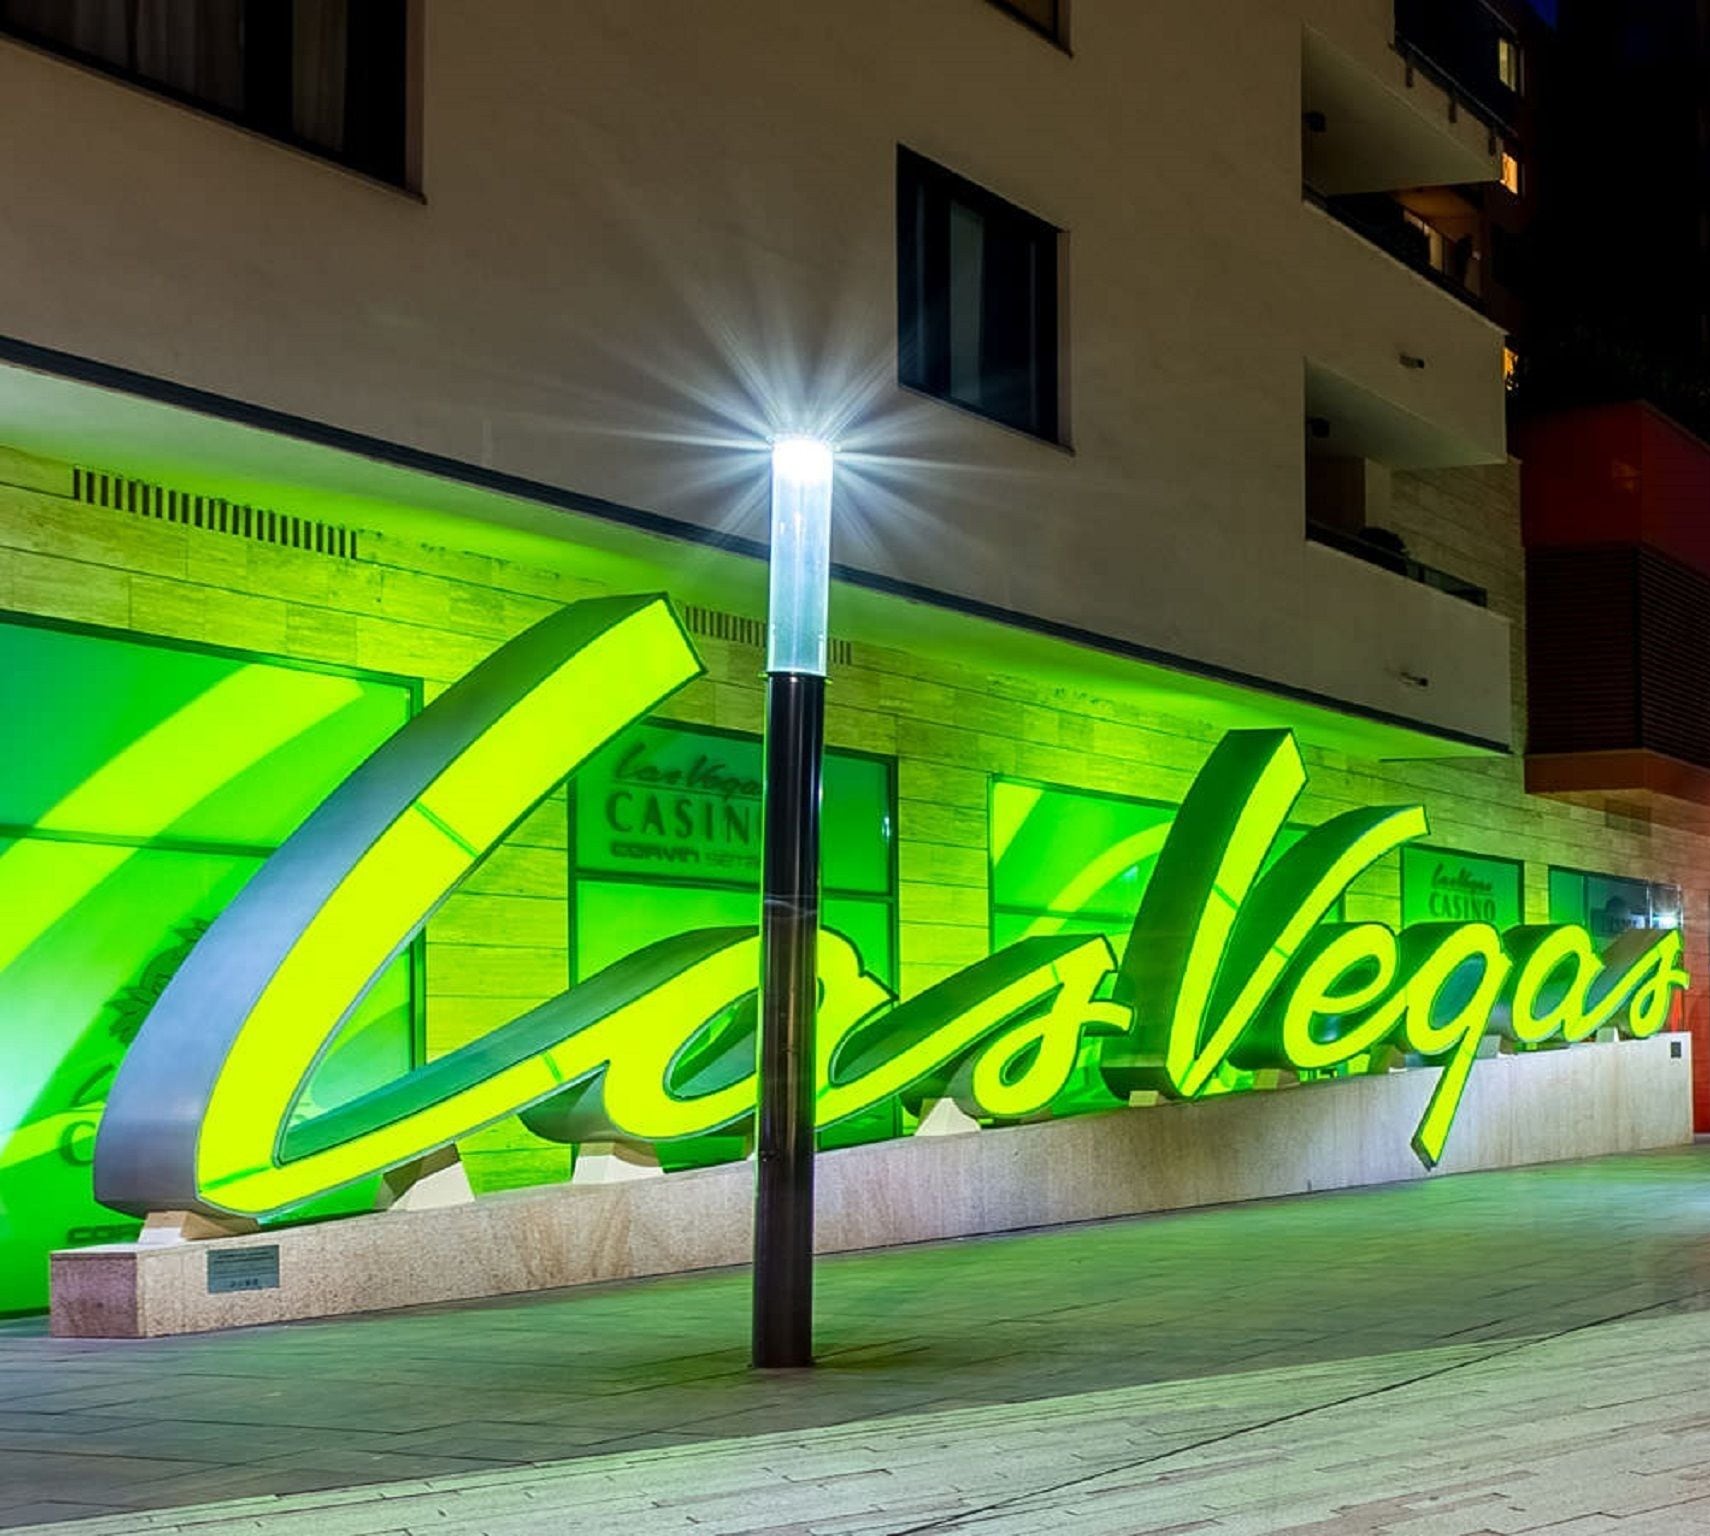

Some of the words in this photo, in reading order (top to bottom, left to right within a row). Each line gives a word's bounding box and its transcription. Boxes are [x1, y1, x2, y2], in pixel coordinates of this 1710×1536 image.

[684, 753, 764, 801] Vega
[604, 790, 764, 845] CASIN
[197, 594, 1135, 1216] Las
[1166, 730, 1690, 1167] Vegas
[1428, 890, 1496, 921] CASINO
